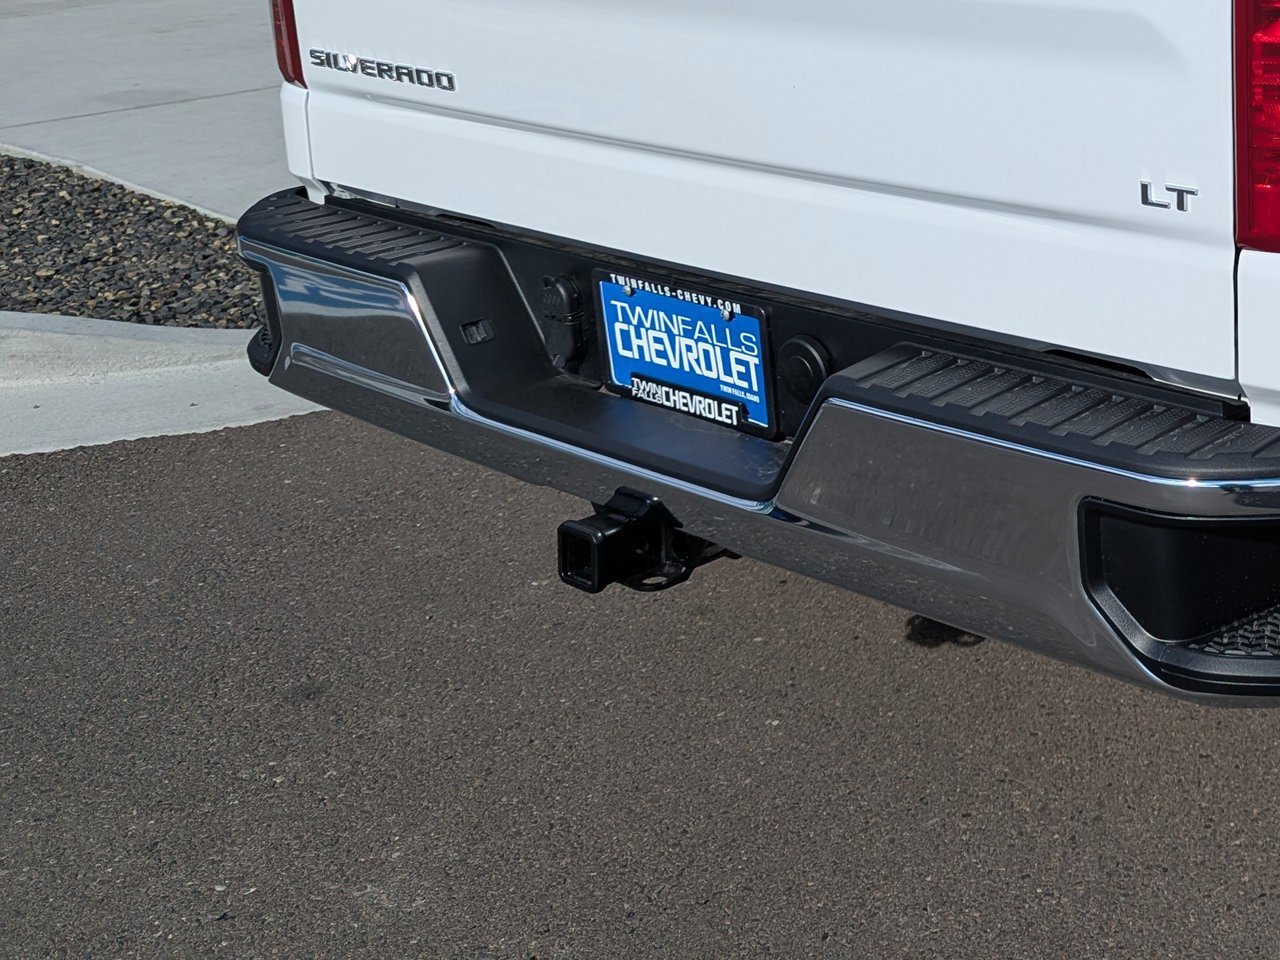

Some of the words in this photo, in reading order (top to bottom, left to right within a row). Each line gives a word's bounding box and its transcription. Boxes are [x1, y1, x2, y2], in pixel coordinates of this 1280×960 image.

[308, 47, 456, 92] SILVERADO
[1139, 179, 1199, 213] LT
[610, 273, 741, 314] TWINFALLS-CHEVY.COM
[614, 322, 760, 392] CHEVROLET
[631, 377, 662, 394] TWIN
[632, 388, 663, 404] FALLS
[661, 386, 738, 426] CHEVROLET
